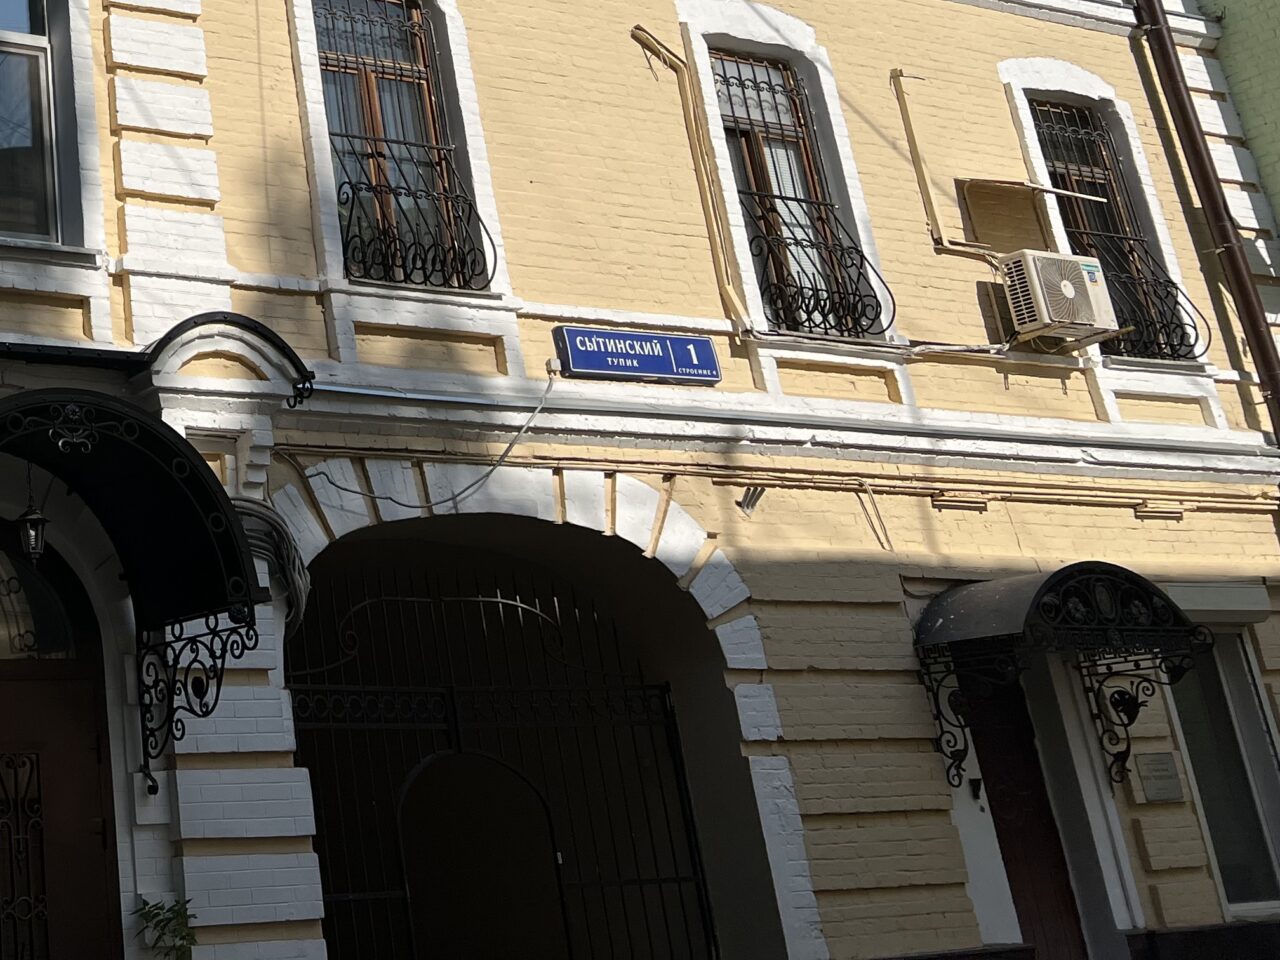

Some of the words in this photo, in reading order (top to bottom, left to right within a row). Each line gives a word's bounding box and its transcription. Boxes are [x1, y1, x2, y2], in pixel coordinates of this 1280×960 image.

[686, 343, 699, 365] 1
[606, 357, 639, 368] ТУПИК
[678, 367, 711, 376] СТРОЕНИЕ
